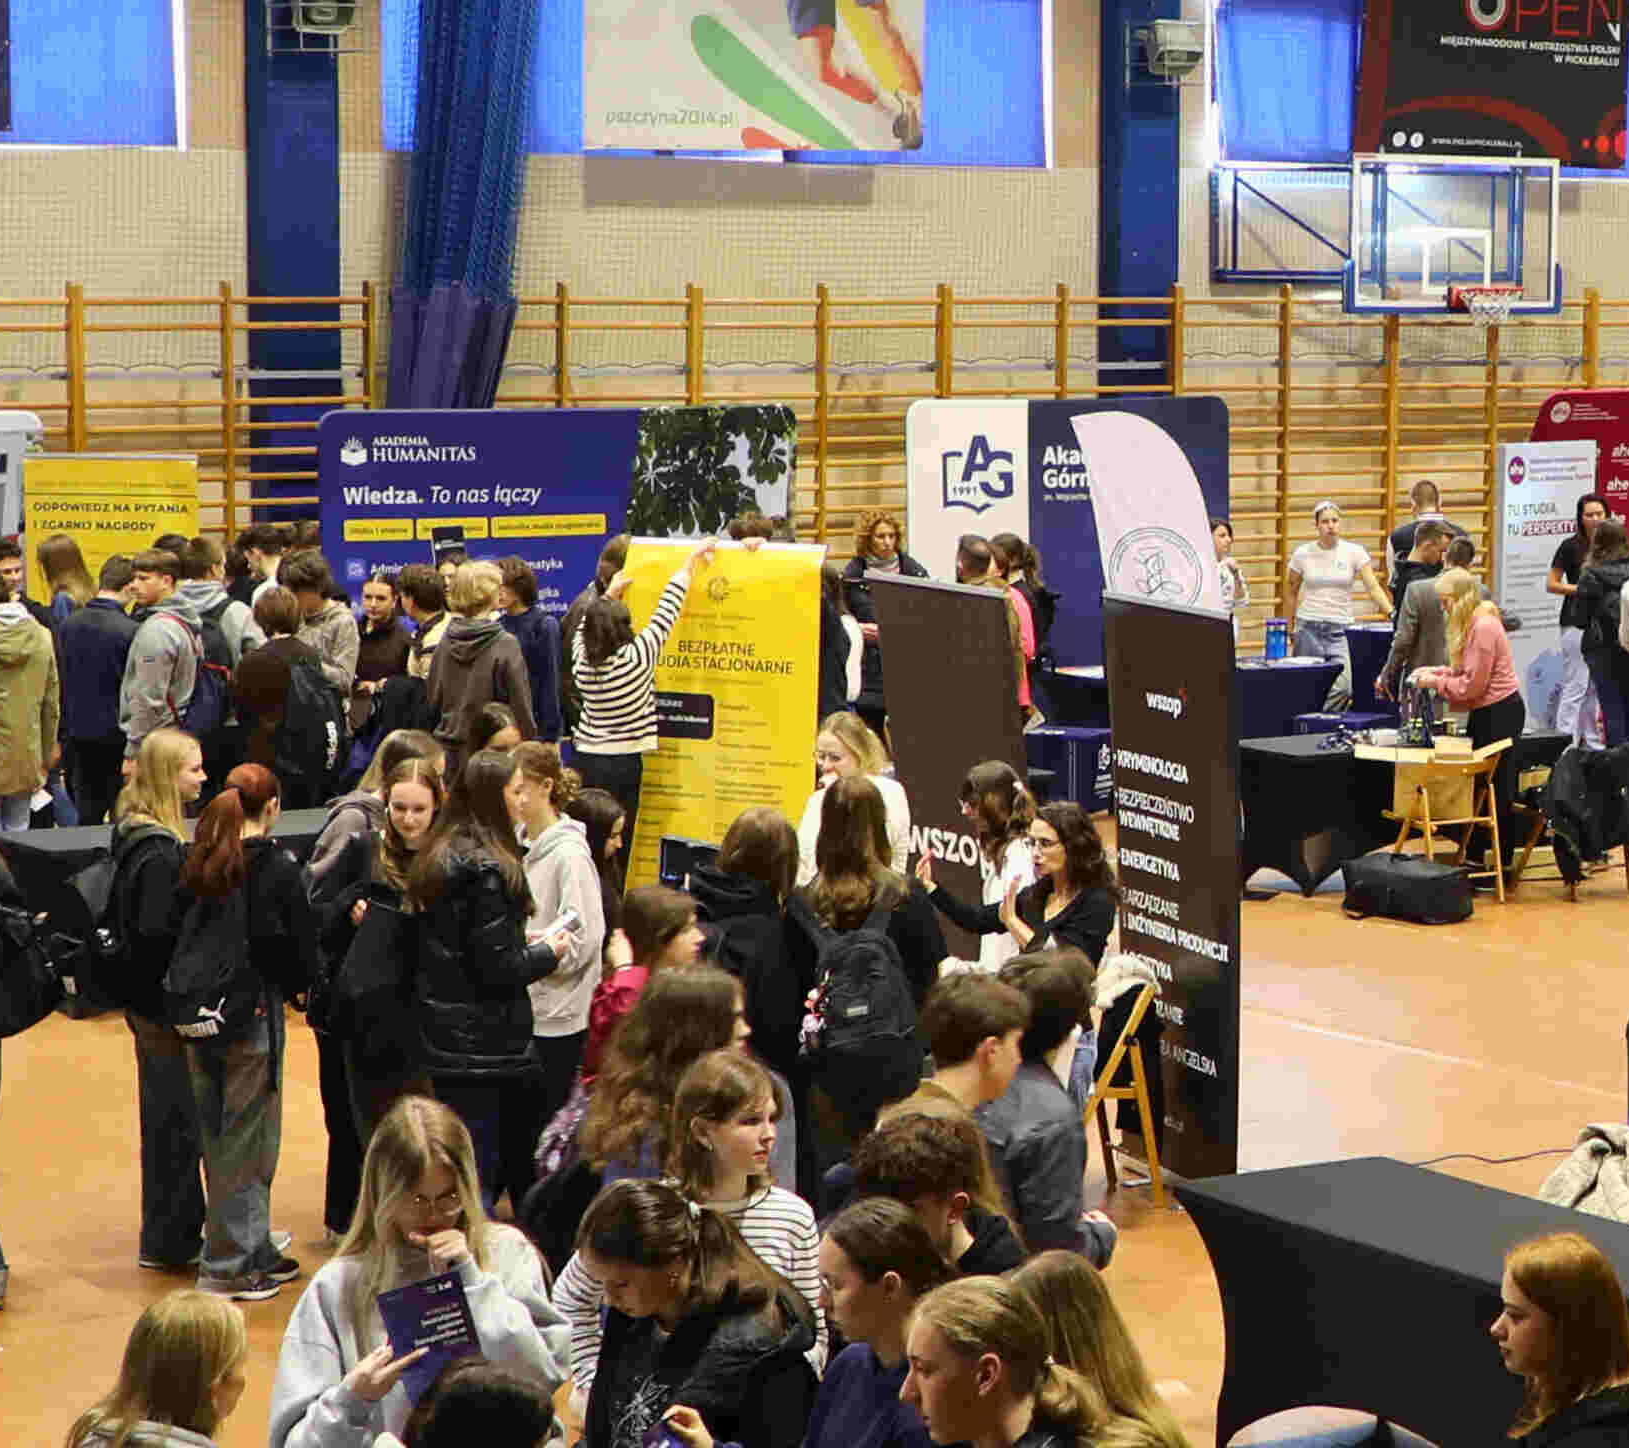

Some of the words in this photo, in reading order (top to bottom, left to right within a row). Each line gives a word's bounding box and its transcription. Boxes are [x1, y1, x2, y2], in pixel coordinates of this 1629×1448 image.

[371, 435, 430, 447] AKADEMIA
[371, 446, 476, 464] HUMANITAS
[1606, 477, 1629, 491] ahe
[342, 485, 425, 505] Wiedza.
[430, 484, 451, 504] To
[456, 488, 489, 504] nas
[493, 483, 543, 507] łączy
[33, 501, 110, 513] ODPOWIEDZ
[113, 502, 132, 513] NA
[134, 502, 189, 513] PYTANIA
[96, 520, 156, 532] NAGRODY
[677, 639, 756, 657] BEZPŁATNE
[692, 656, 795, 675] STACJONARNE
[1116, 749, 1189, 784] KRYMINOLOGIA
[1118, 786, 1195, 825] BEZPIECZEŃSTWO
[1118, 808, 1180, 842] WEWNĘTRZNE
[1120, 847, 1181, 882] ENERGETYKA
[1127, 912, 1177, 946] INŻYNIERIA
[1177, 929, 1229, 963] PRODUKCJI
